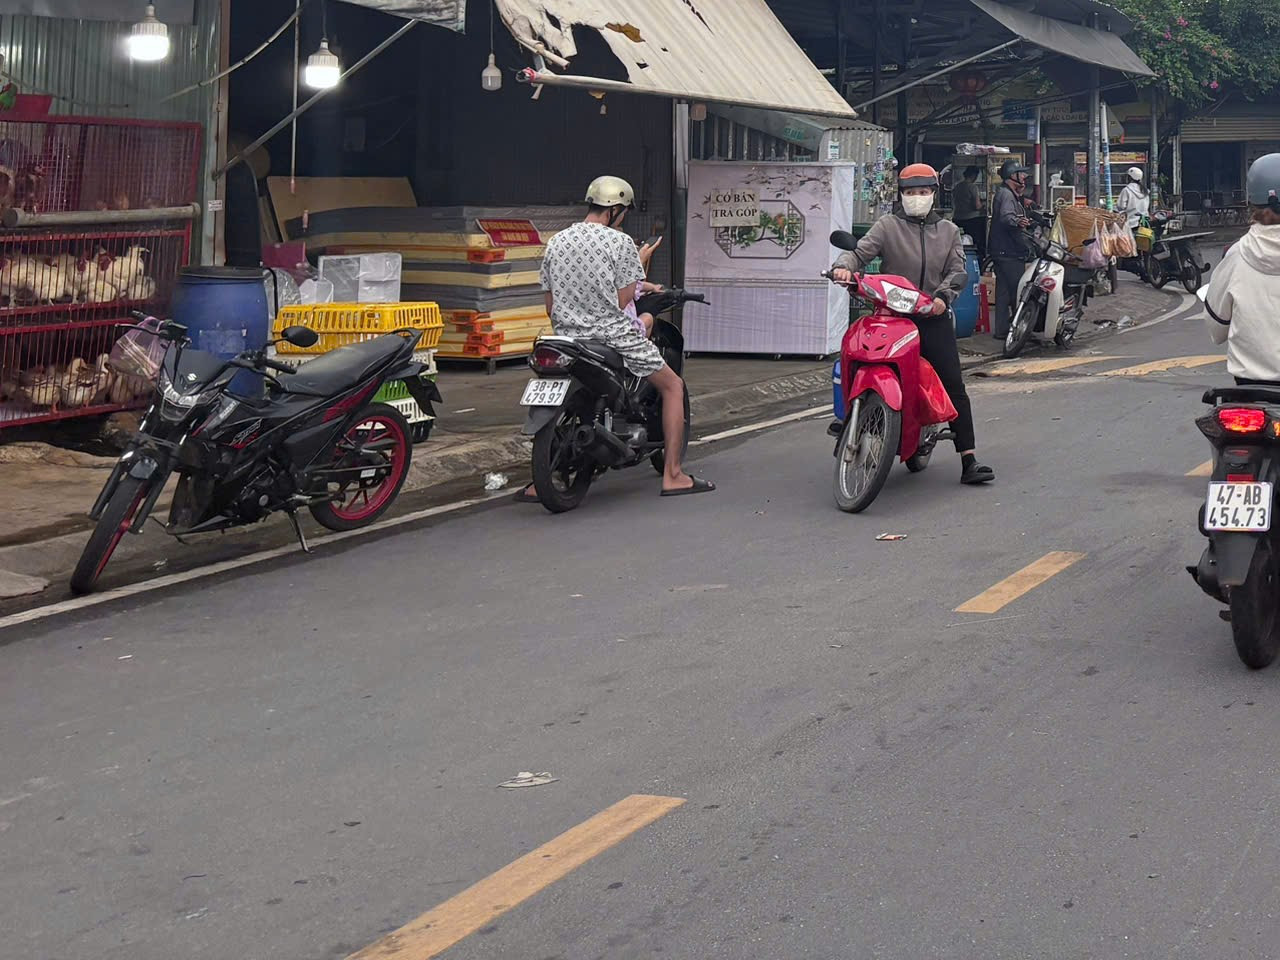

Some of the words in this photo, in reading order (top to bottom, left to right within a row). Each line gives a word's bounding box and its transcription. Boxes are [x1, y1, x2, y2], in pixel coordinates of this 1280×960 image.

[716, 192, 731, 203] CÓ
[734, 192, 756, 203] BÁN
[712, 206, 733, 218] TRẢ
[736, 206, 758, 218] GÓP
[532, 381, 563, 392] 38-P1
[525, 393, 562, 404] 479.97
[1216, 485, 1262, 506] 47-AB
[1209, 507, 1266, 528] 454.73
